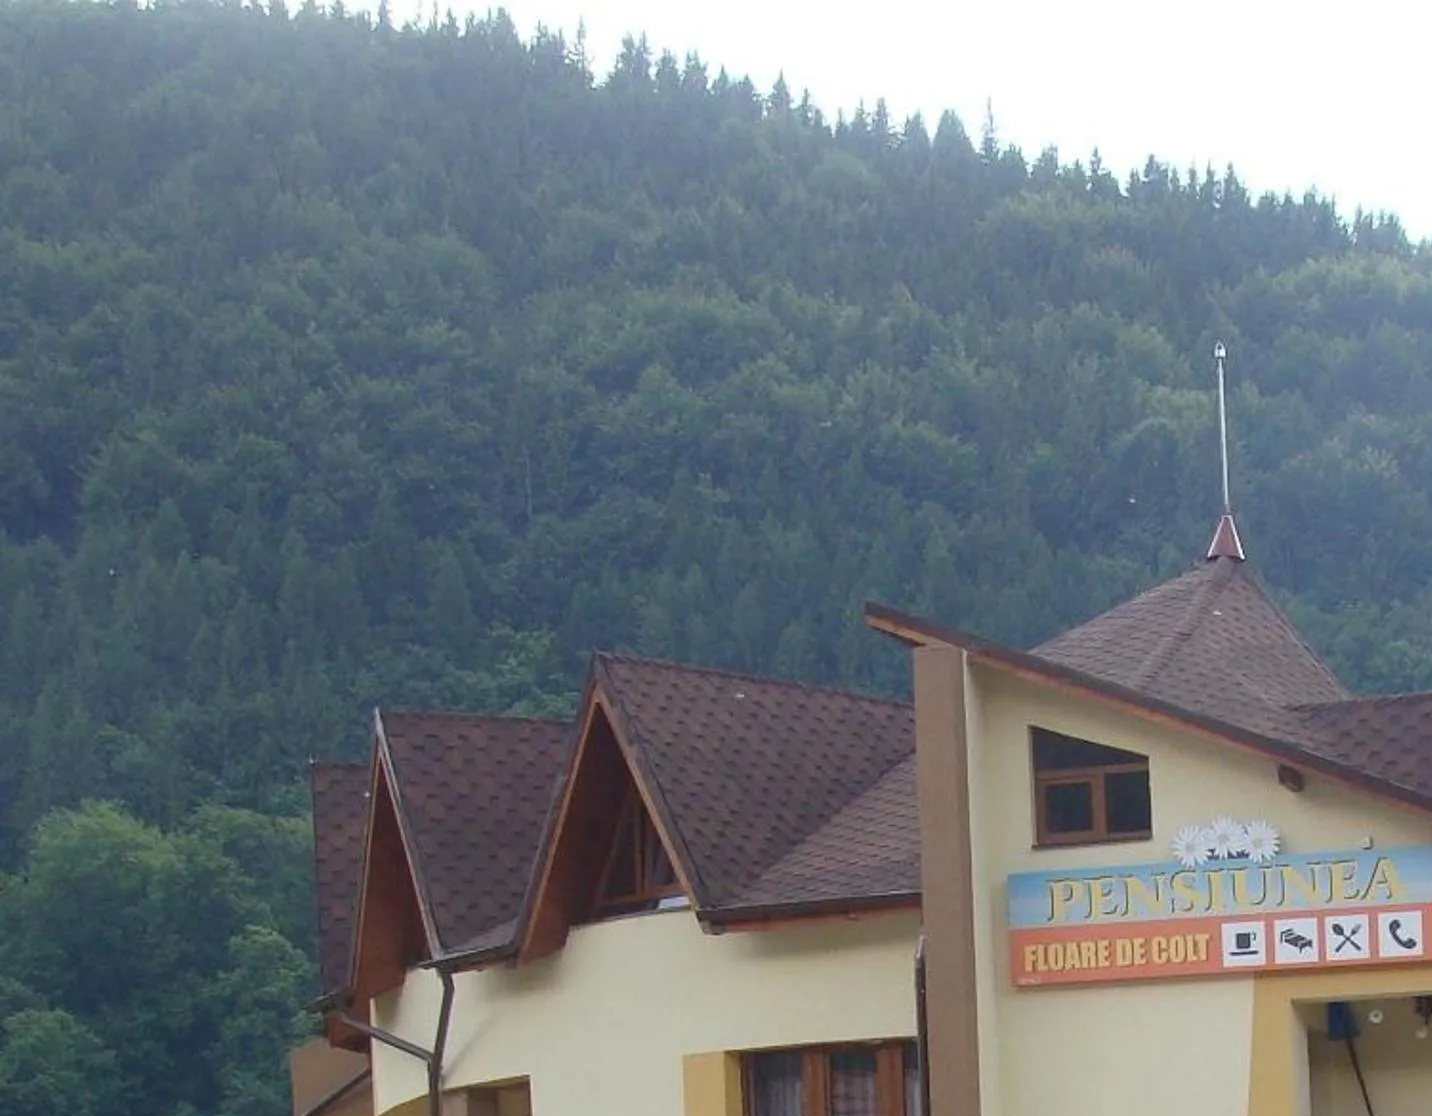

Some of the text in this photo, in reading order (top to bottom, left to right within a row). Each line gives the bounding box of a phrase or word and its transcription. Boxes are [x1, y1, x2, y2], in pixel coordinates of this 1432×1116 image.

[1046, 856, 1406, 922] PENSIUNEA
[1023, 933, 1210, 972] FLOARE DE COLT
